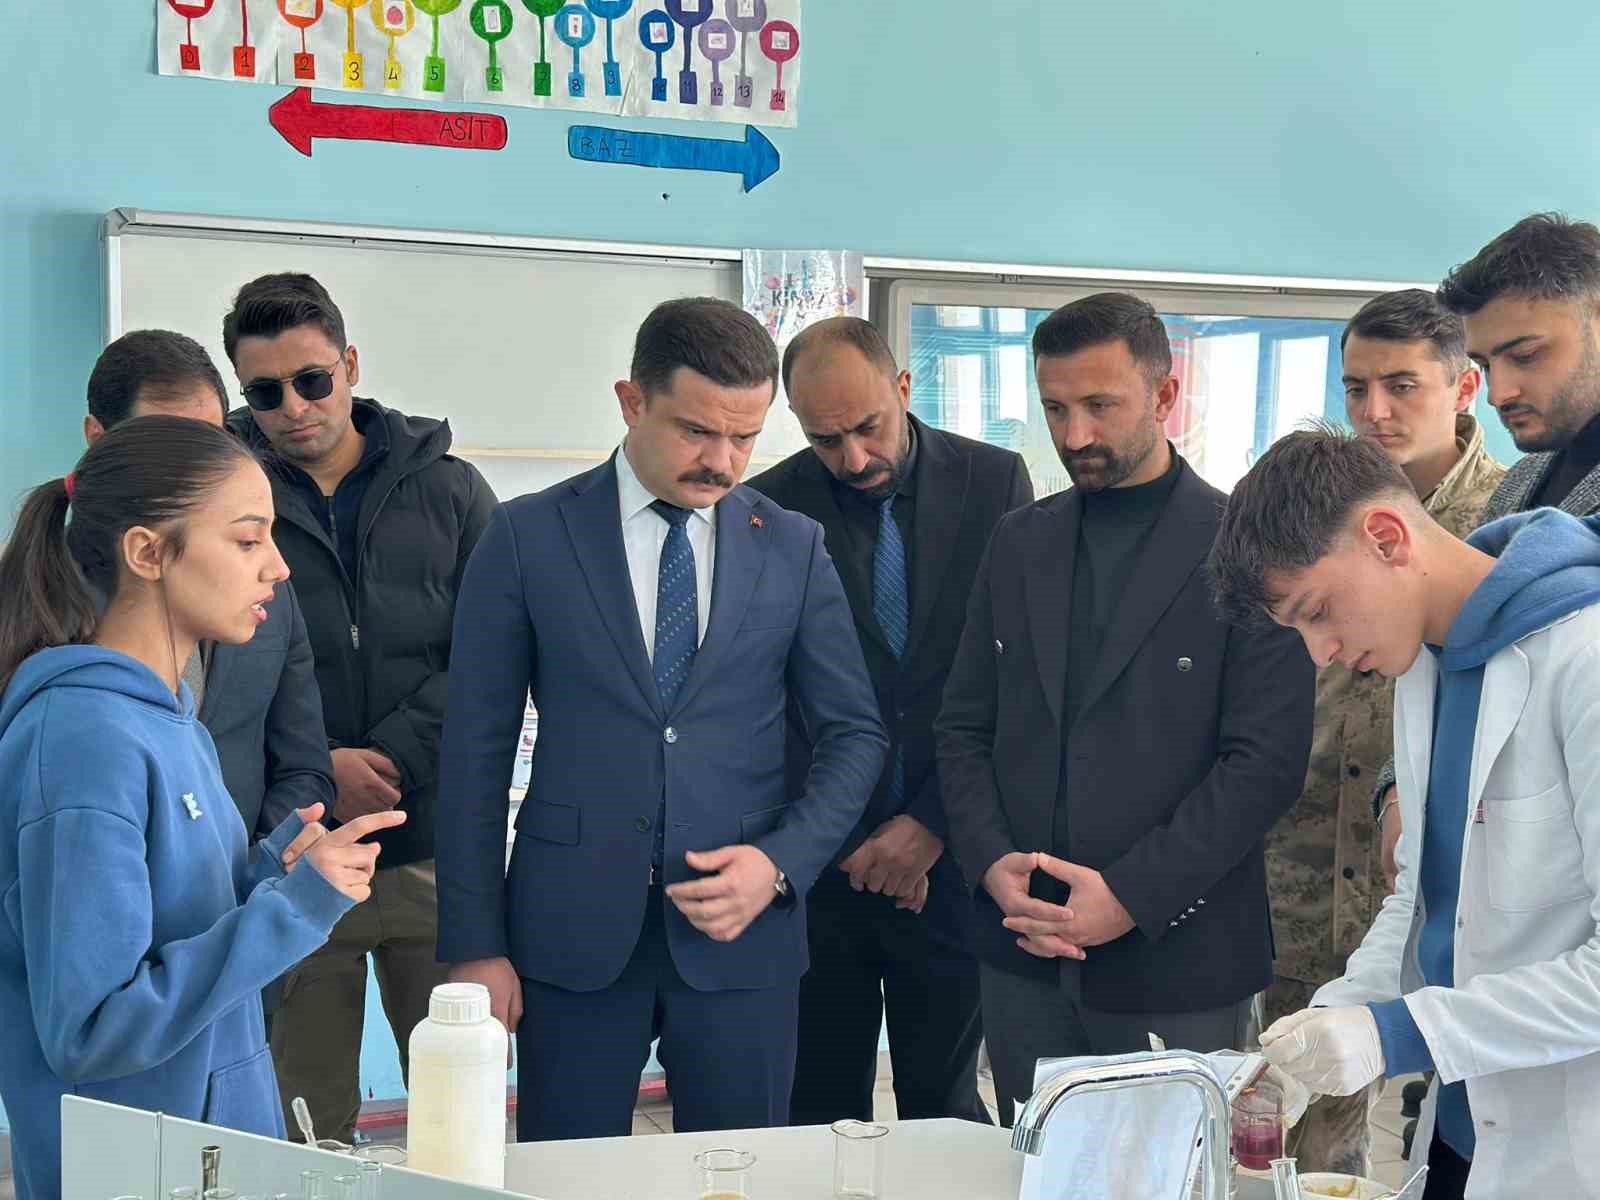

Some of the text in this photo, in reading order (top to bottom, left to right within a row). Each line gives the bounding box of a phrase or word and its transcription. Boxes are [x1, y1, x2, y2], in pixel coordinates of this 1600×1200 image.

[240, 52, 250, 68] 1
[299, 55, 309, 71] 2
[349, 61, 360, 80] 3
[388, 65, 398, 80] 4
[430, 65, 440, 81] 5
[491, 71, 501, 85] 6
[712, 87, 724, 98] 12
[737, 85, 750, 98] 13
[580, 136, 632, 157] BAZ
